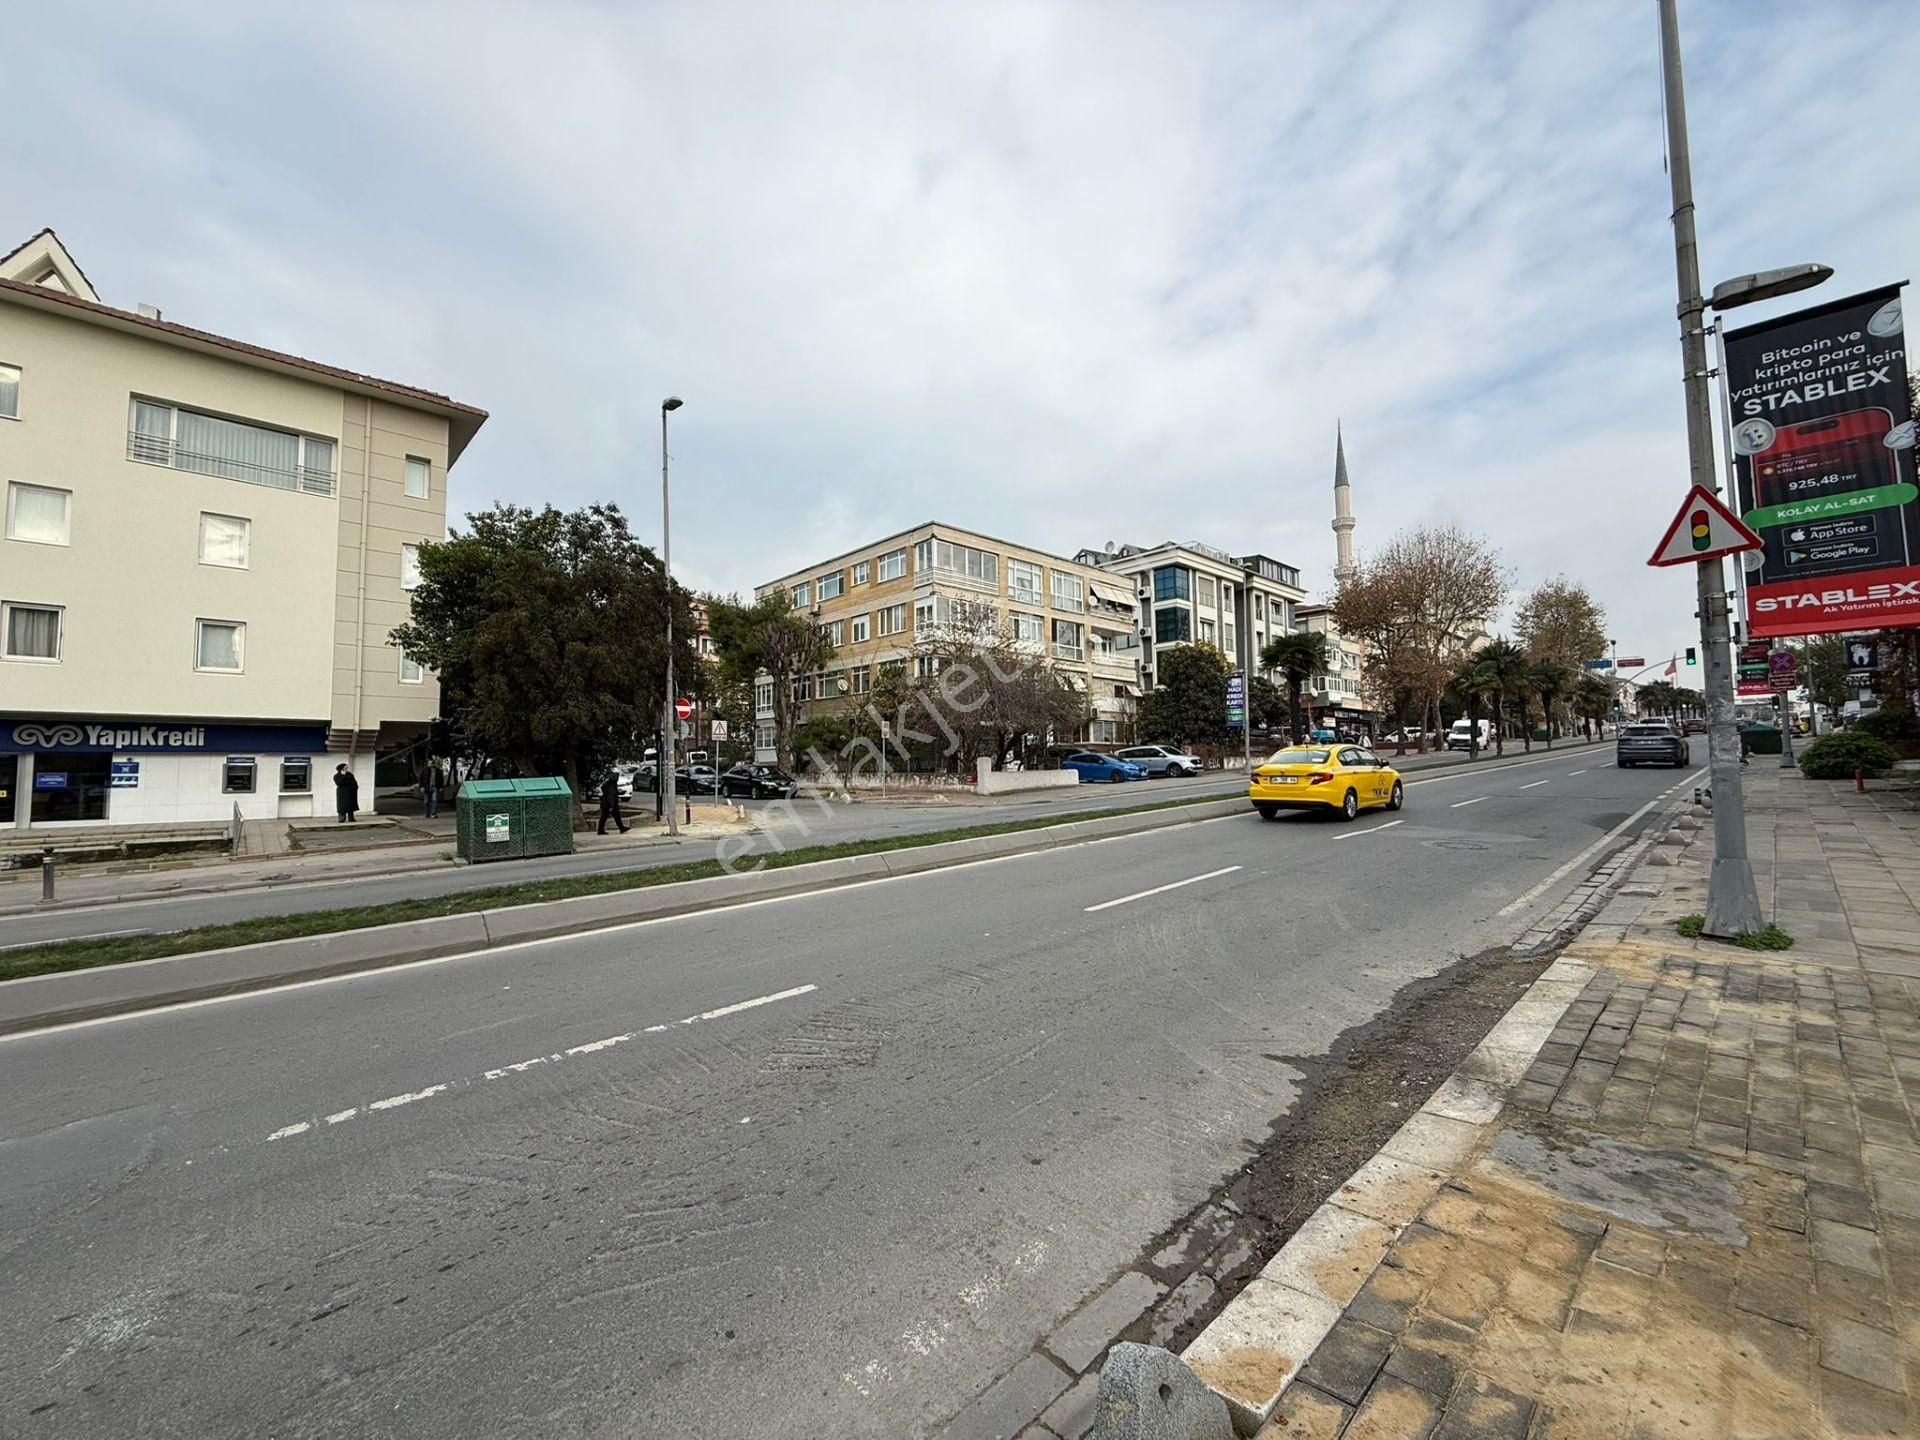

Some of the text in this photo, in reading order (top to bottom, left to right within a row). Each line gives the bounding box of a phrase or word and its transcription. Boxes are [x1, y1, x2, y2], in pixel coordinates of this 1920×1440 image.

[1761, 330, 1862, 364] Bitcoin ve
[1755, 344, 1866, 380] kripto para
[1730, 349, 1904, 402] yatırımlarınız için
[1743, 366, 1892, 416] STABLEX
[1789, 473, 1857, 491] 925,48 TRY
[1777, 494, 1877, 519] KOLAY AL-SAT
[1810, 525, 1868, 539] App Store
[1810, 546, 1870, 560] Google Play
[1755, 580, 1920, 612] STABLEX
[1823, 605, 1838, 613] Ak
[1840, 602, 1880, 612] Yatırım
[84, 725, 205, 749] YapıKredi
